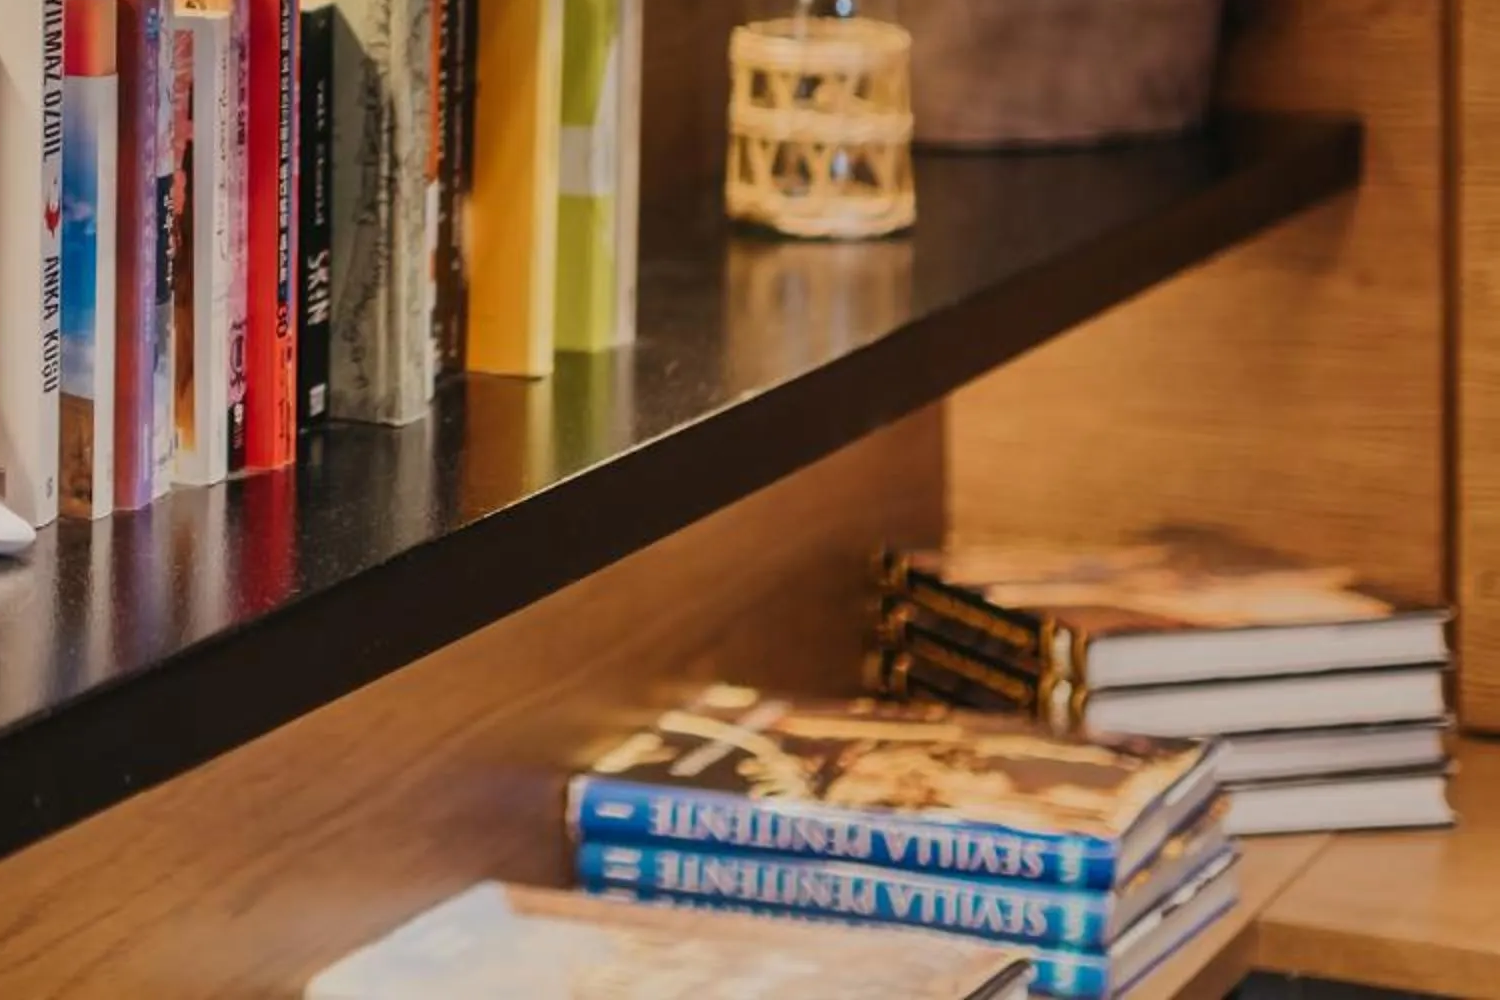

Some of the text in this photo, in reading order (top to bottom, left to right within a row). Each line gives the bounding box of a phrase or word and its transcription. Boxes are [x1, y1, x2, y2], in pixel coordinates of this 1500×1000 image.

[44, 255, 60, 321] ANKA
[307, 249, 331, 326] SKIN
[648, 797, 873, 859] PENITENTE
[884, 823, 1046, 878] SEVILLA
[654, 852, 878, 918] PENITENTE
[887, 882, 1051, 938] SEVILLA
